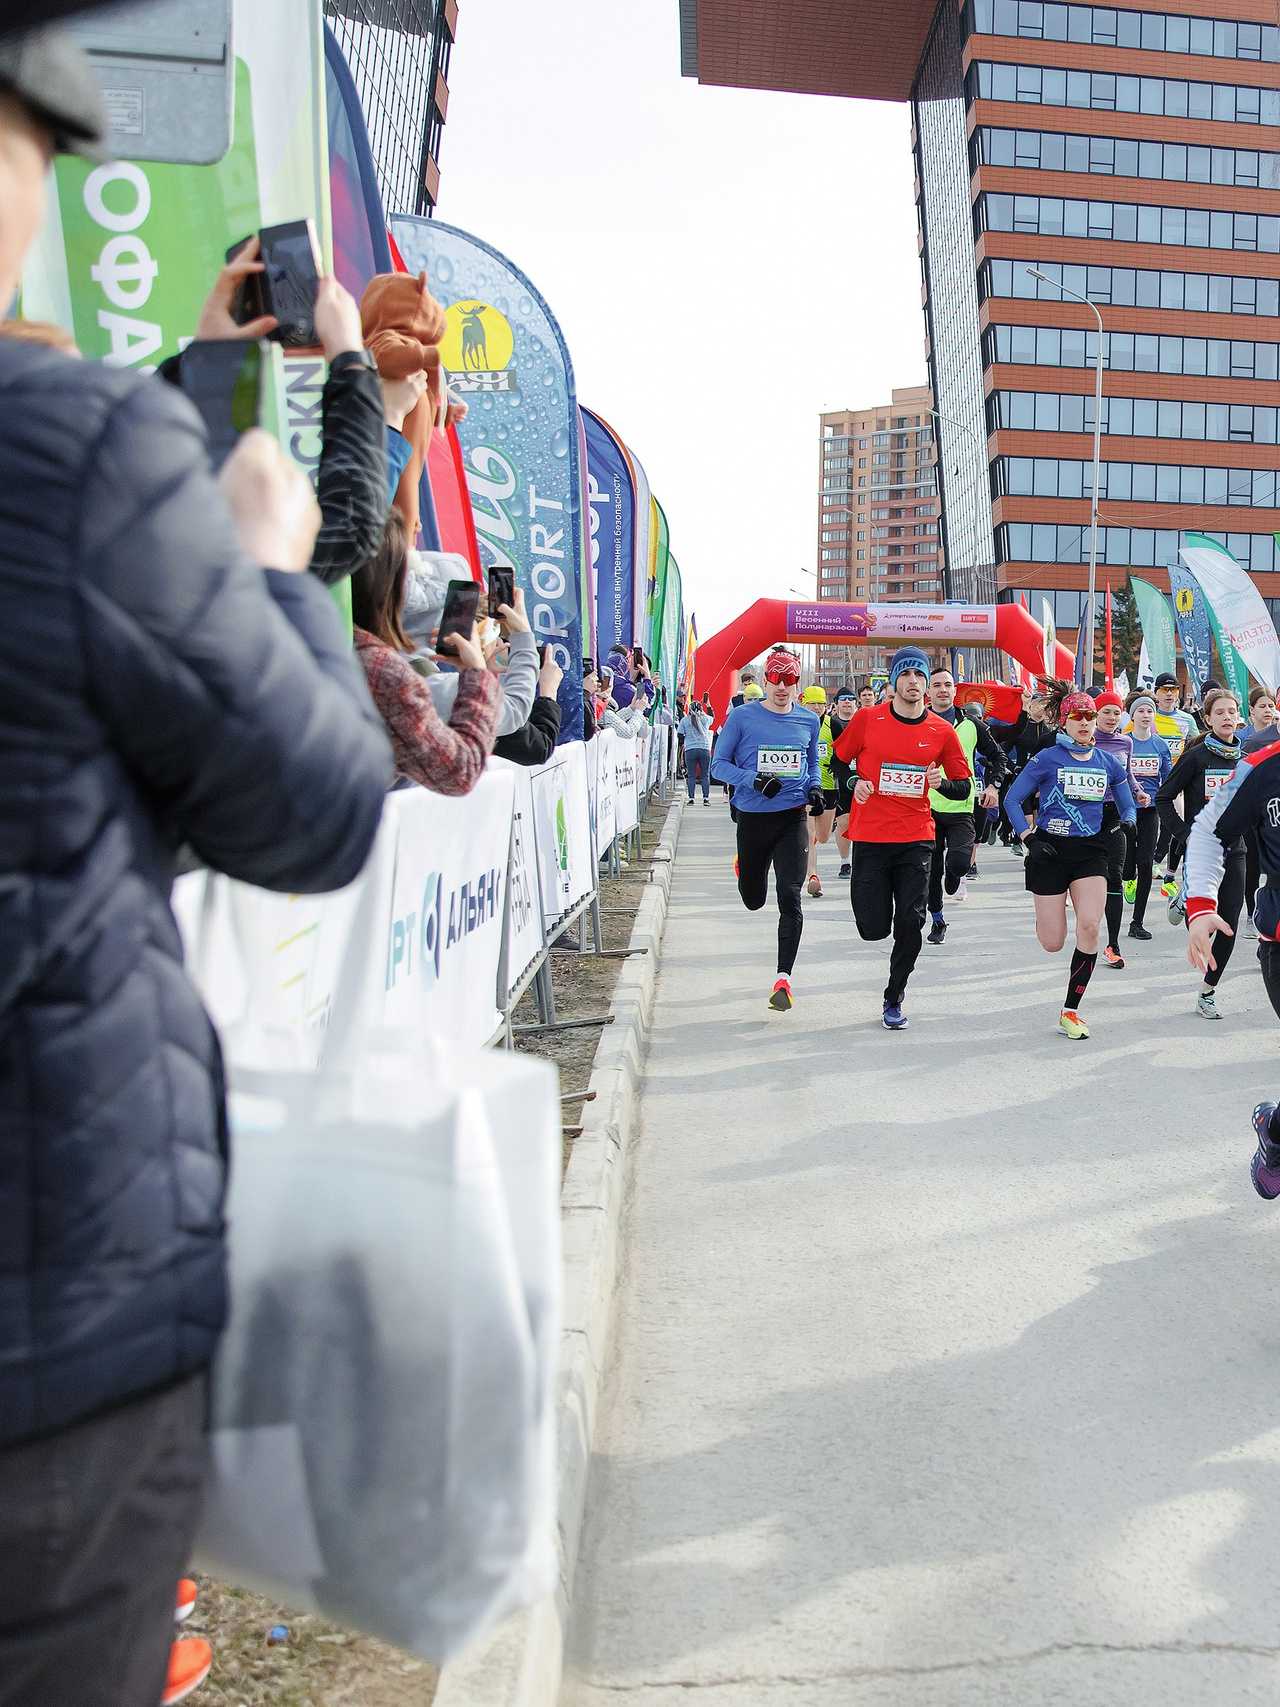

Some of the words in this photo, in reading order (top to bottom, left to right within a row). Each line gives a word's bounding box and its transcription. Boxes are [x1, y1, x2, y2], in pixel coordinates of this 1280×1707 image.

[795, 616, 841, 624] Весенний
[795, 623, 858, 631] Полумарафон
[761, 753, 799, 764] 1001
[1131, 759, 1159, 768] 5165
[881, 771, 924, 786] 5332
[1067, 775, 1105, 789] 1106
[1206, 777, 1225, 788] 51
